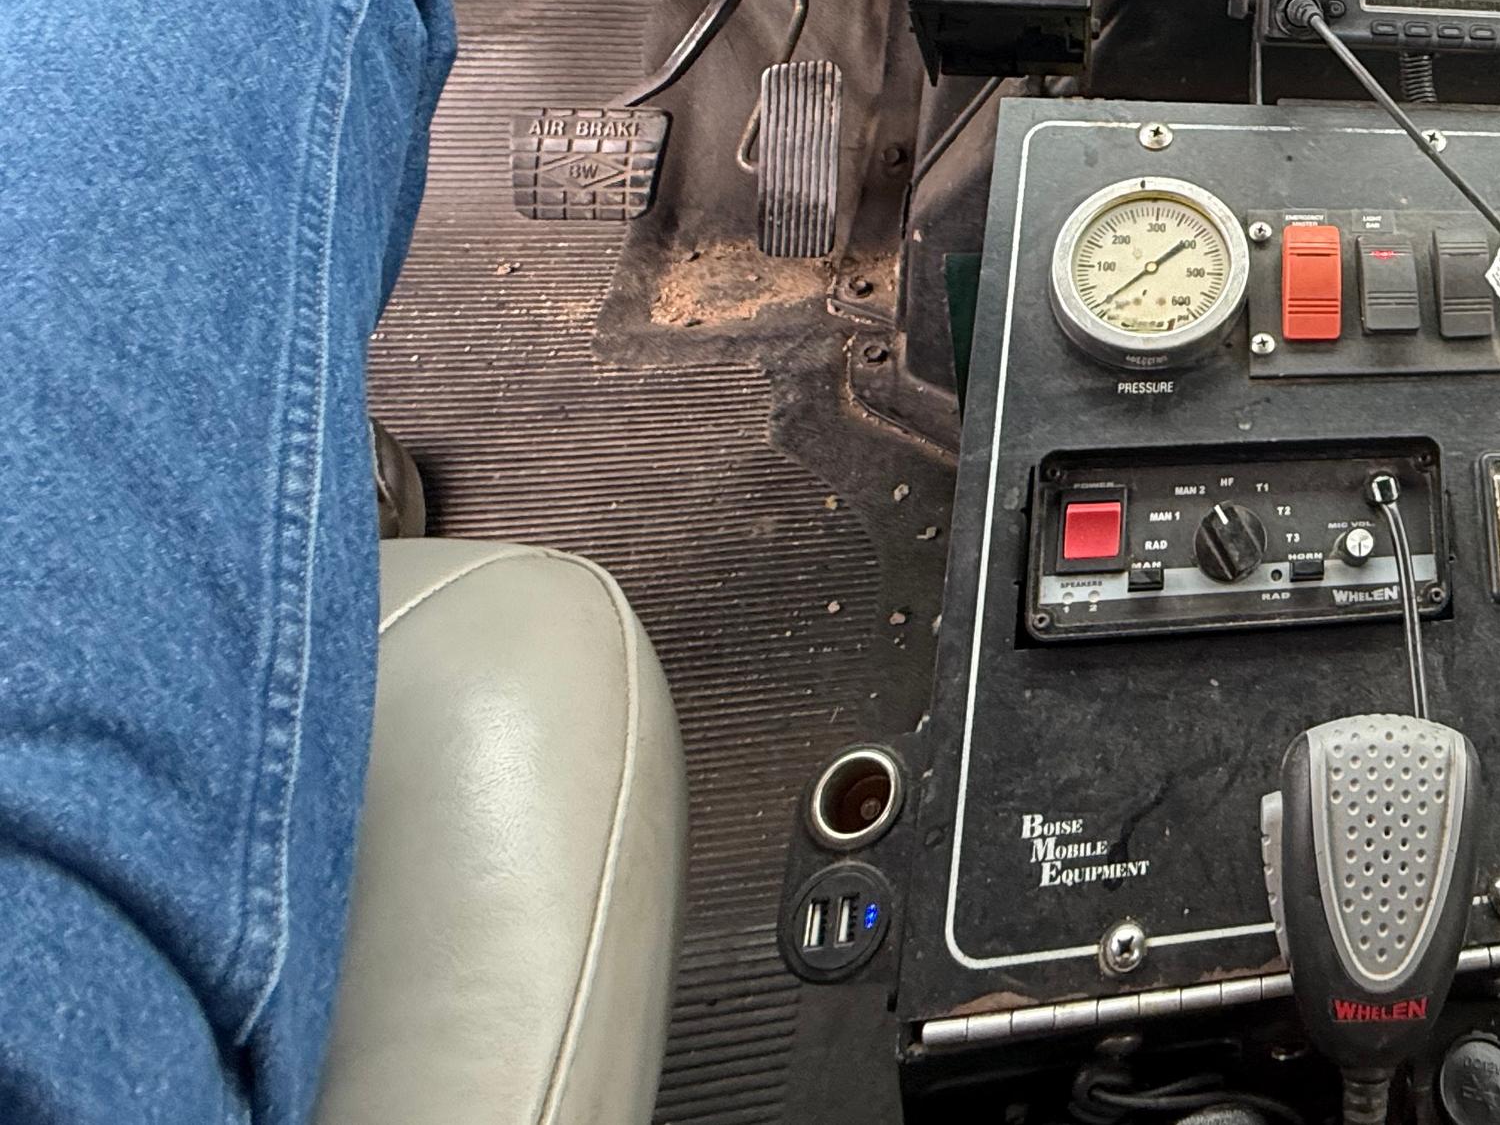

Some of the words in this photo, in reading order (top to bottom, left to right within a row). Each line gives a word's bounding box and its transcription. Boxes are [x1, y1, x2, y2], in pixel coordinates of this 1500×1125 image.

[528, 119, 565, 136] AIR
[569, 163, 600, 179] BW
[1146, 223, 1166, 233] 300
[1112, 235, 1131, 245] 200
[1179, 239, 1197, 250] 400
[1096, 261, 1116, 272] 100
[1186, 267, 1205, 278] 500
[1171, 296, 1191, 306] 600
[1177, 315, 1190, 323] psi
[1117, 381, 1174, 394] PRESSURE
[1220, 477, 1235, 486] HF
[1174, 486, 1196, 496] MAN
[1198, 485, 1206, 494] 2
[1256, 482, 1269, 492] T1
[1277, 506, 1292, 516] T2
[1149, 512, 1172, 522] MAN
[1174, 511, 1181, 521] 1
[1327, 521, 1349, 529] MIC
[1286, 533, 1300, 543] T3
[1144, 540, 1168, 551] RAD
[1287, 552, 1323, 561] HORN
[1131, 561, 1162, 569] MAN
[1060, 580, 1103, 589] SPEAKERS
[1261, 592, 1291, 601] RAD
[1332, 585, 1399, 604] WHELEN
[1063, 605, 1070, 614] 1
[1088, 604, 1098, 612] 2
[1333, 997, 1429, 1023] WHELEN
